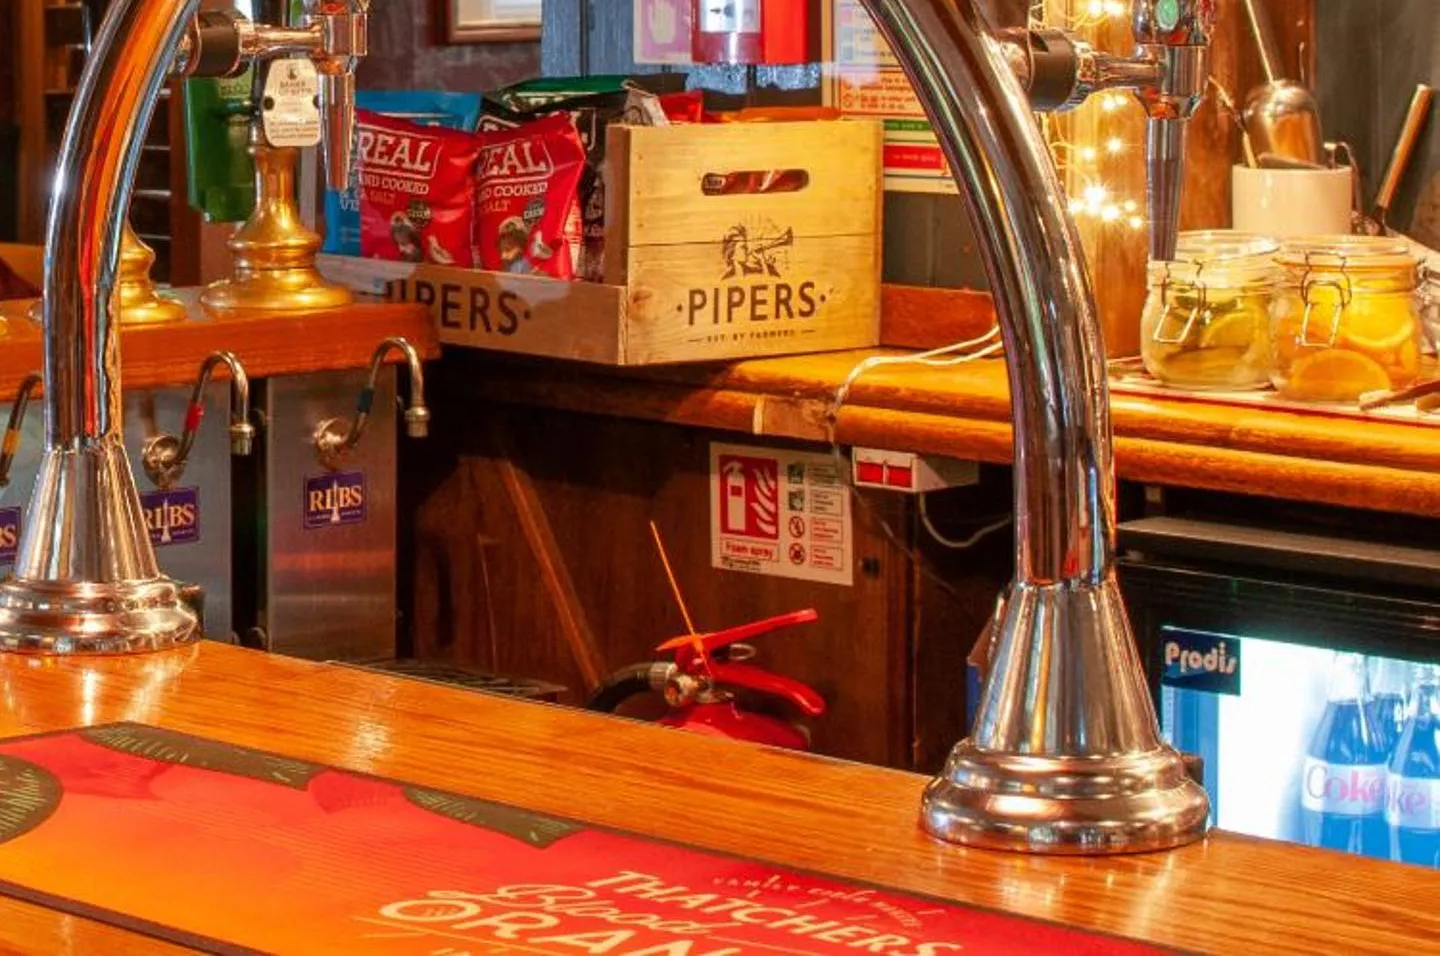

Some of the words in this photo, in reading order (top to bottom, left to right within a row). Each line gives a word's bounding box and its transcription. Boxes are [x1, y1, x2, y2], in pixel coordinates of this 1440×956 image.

[358, 130, 432, 173] REAL
[688, 281, 816, 327] PIPERS
[1164, 640, 1237, 676] Prodis
[1307, 763, 1382, 805] Coke
[427, 883, 743, 936] Blood
[586, 869, 964, 956] THATCHERS
